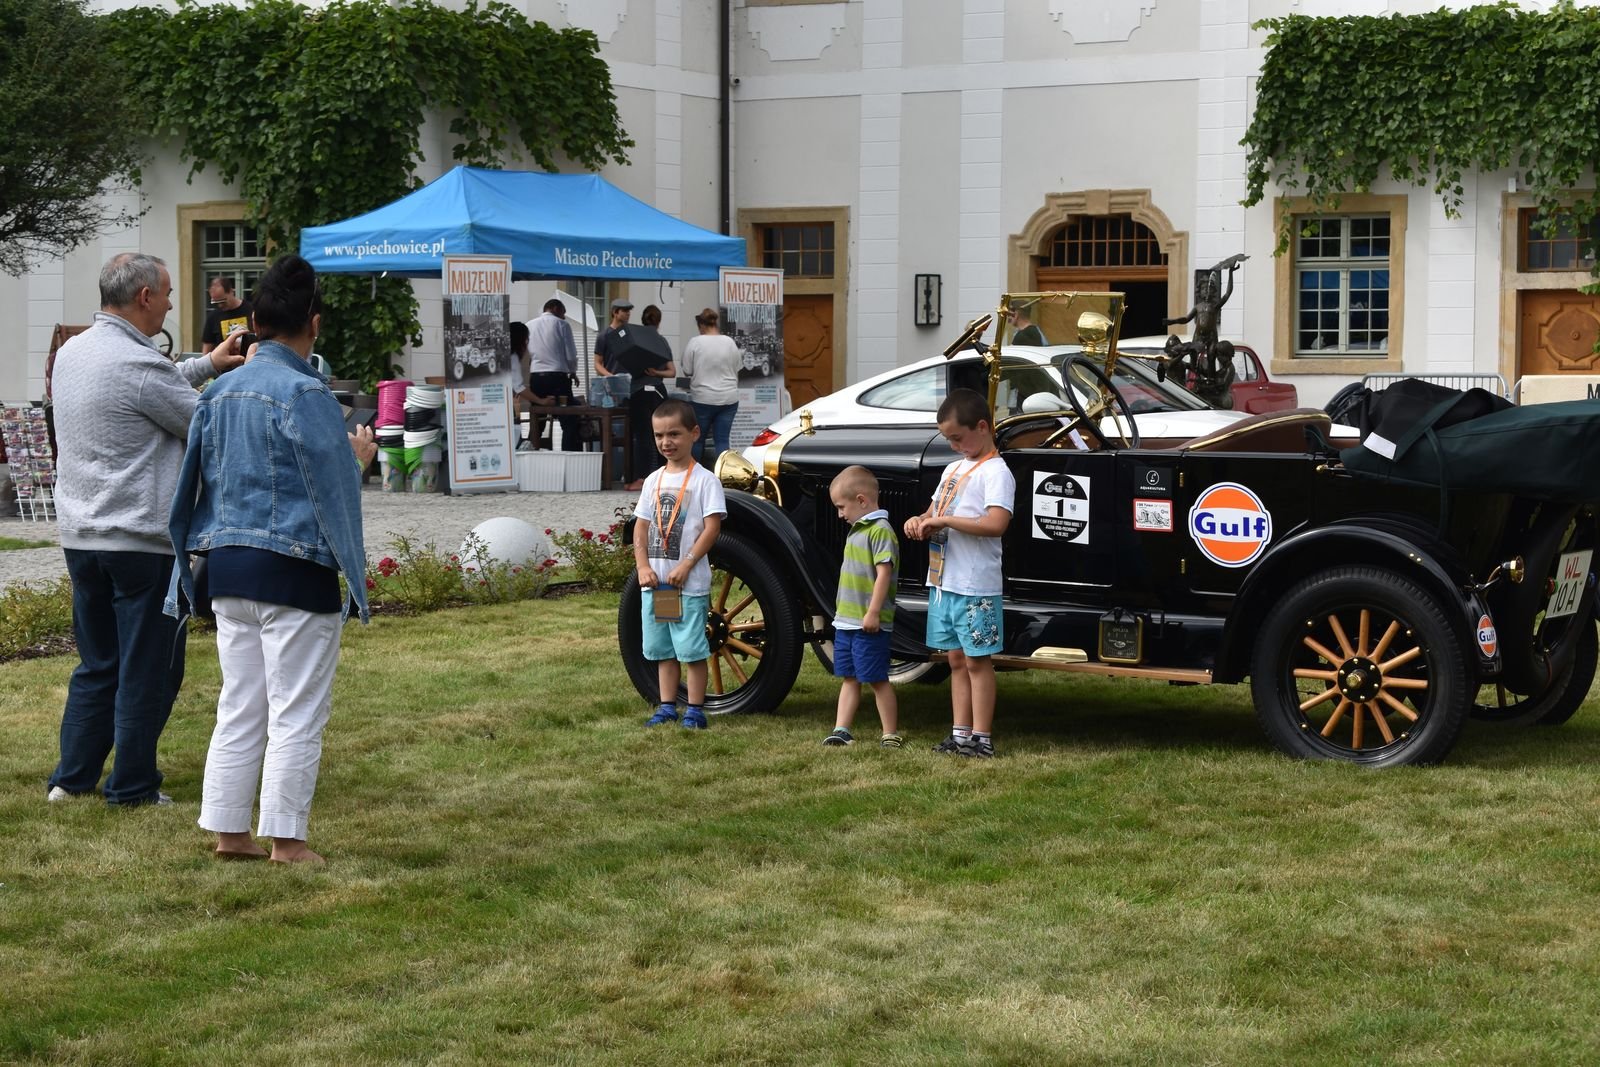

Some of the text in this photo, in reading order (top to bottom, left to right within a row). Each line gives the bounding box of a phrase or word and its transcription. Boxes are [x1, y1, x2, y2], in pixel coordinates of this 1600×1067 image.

[324, 238, 445, 260] www.piechowice.pl
[554, 247, 673, 269] Miasto Piechowice
[451, 270, 505, 293] MUZEUM
[727, 281, 777, 303] MUZEUM
[1054, 498, 1065, 518] 1
[1194, 511, 1267, 538] Gulf
[1564, 556, 1582, 580] WL
